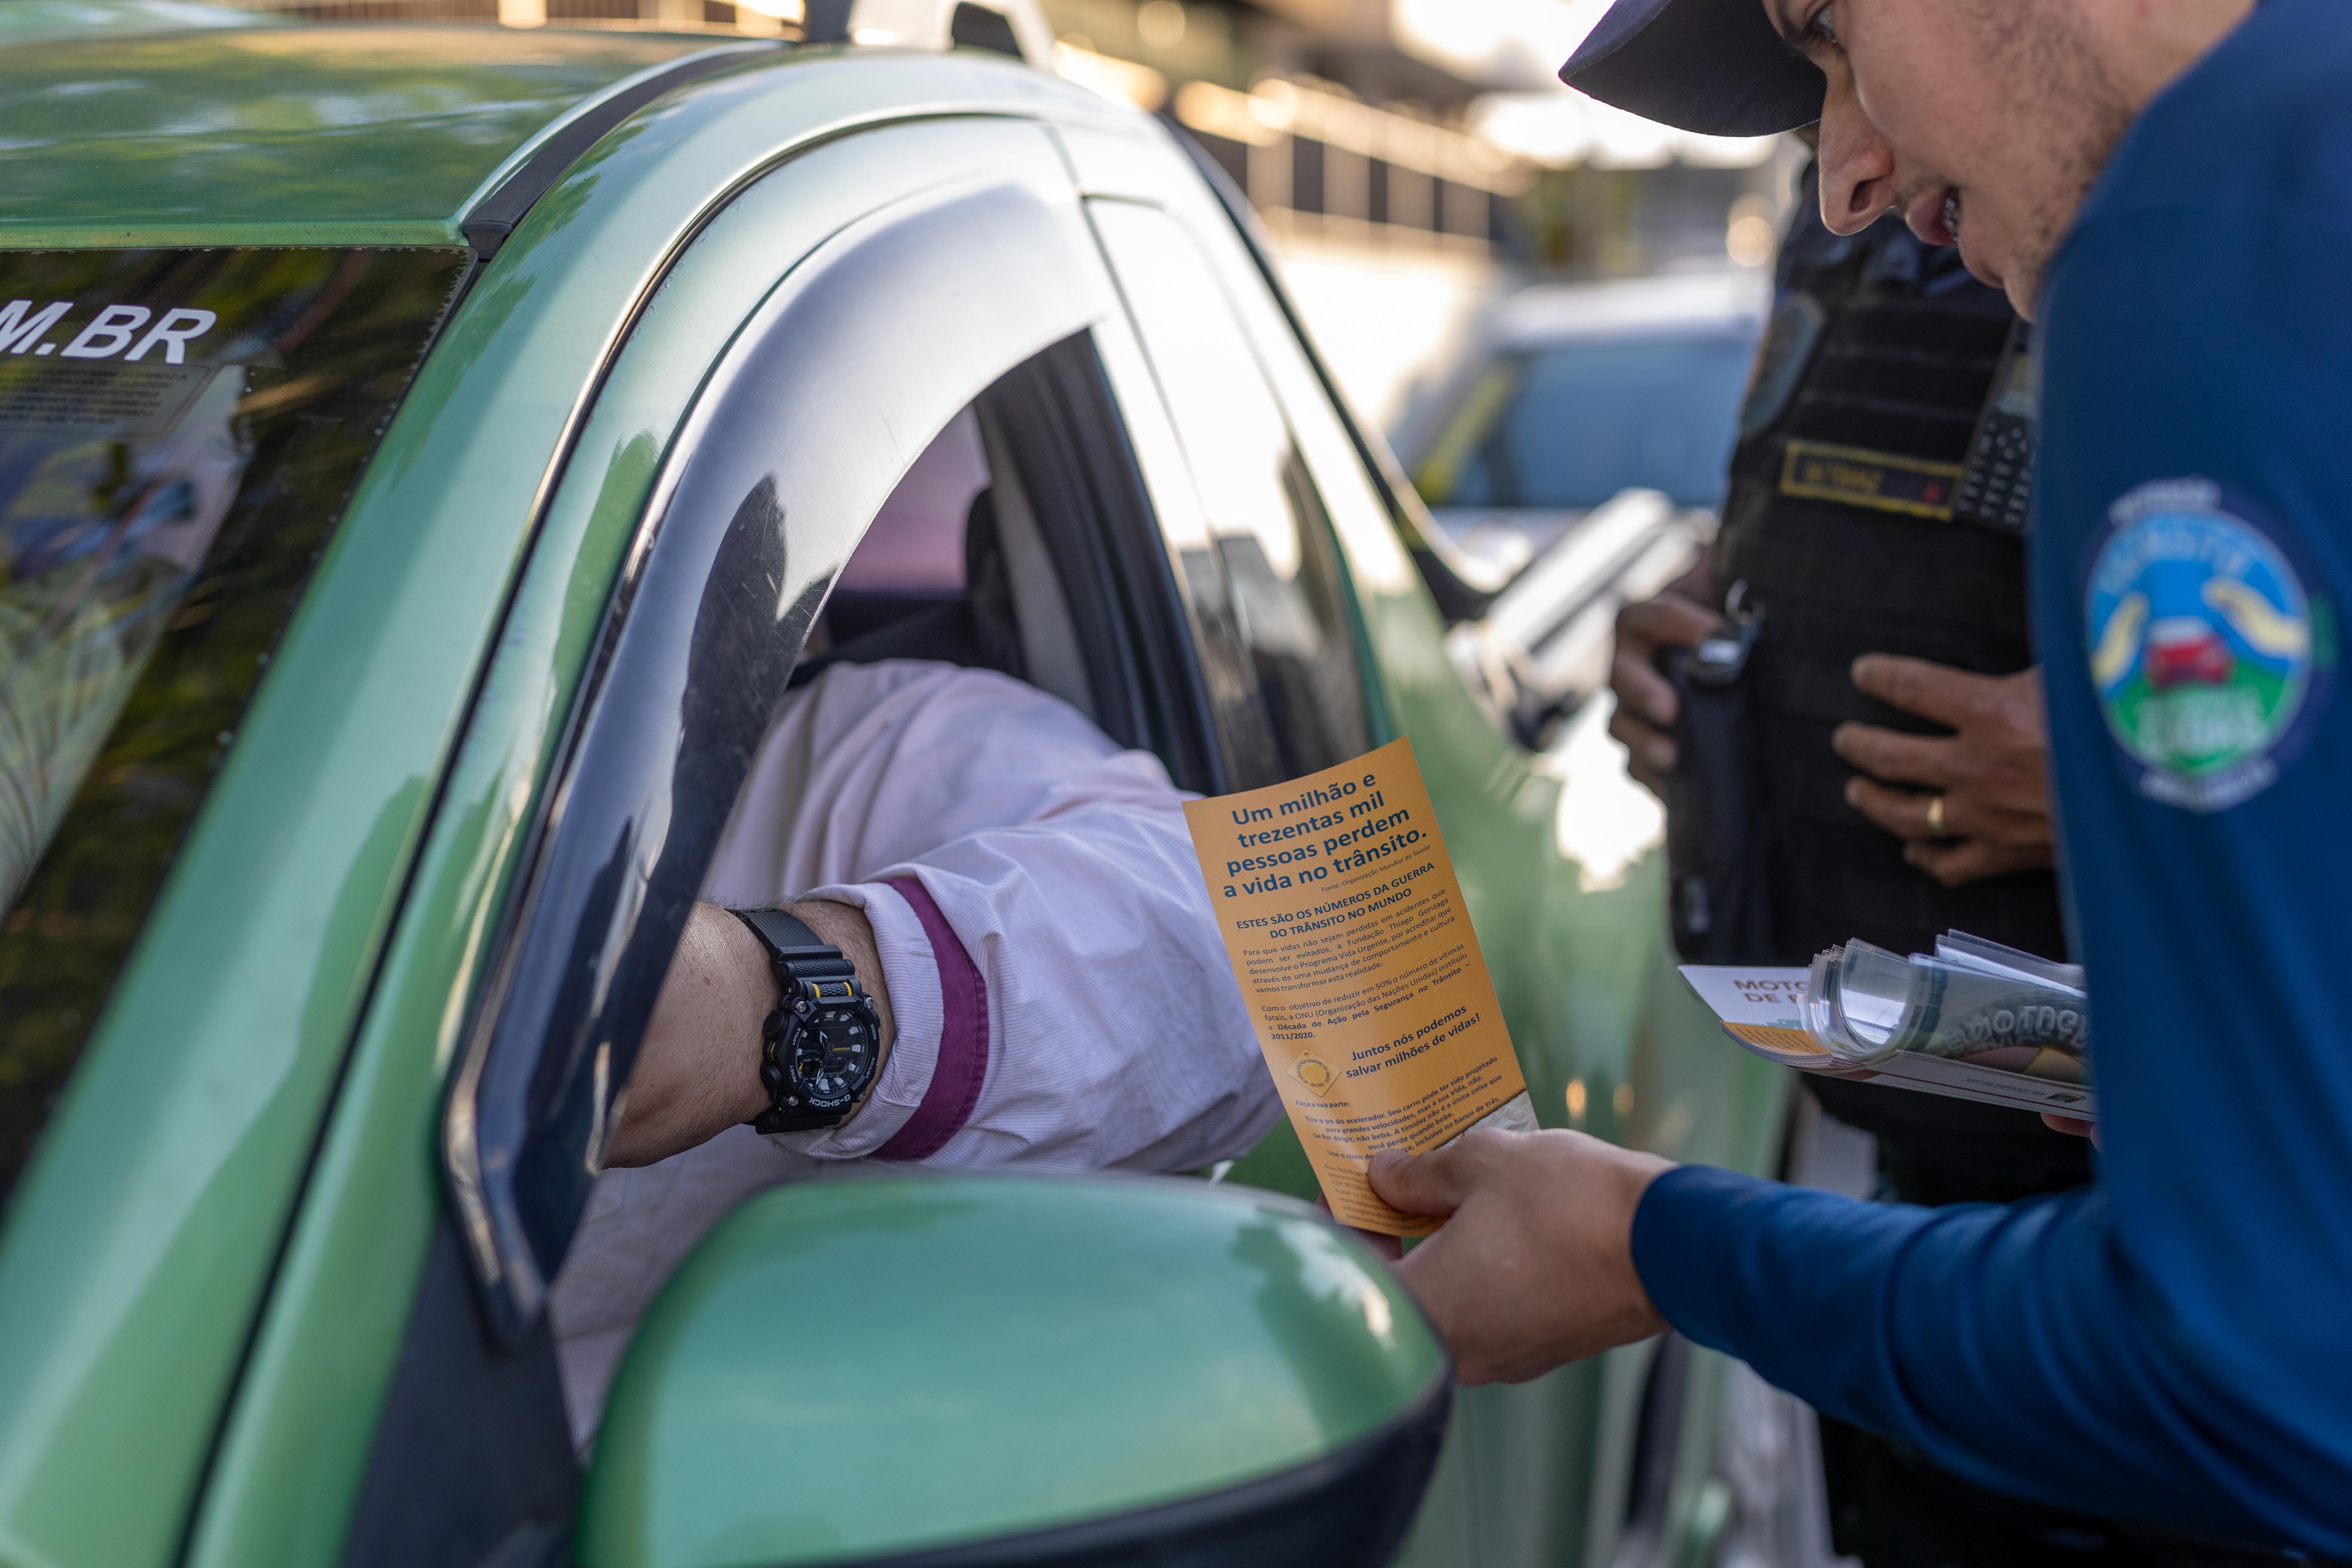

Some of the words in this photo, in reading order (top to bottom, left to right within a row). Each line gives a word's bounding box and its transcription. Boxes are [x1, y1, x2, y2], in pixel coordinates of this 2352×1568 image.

[1232, 808, 1273, 825] Um
[1279, 782, 1357, 816] milhão
[1363, 774, 1376, 787] e
[1237, 811, 1344, 848] trezentas
[1349, 790, 1384, 818] mil
[1223, 885, 1237, 897] a
[1242, 873, 1292, 894] vida
[1298, 867, 1328, 884] no
[1332, 830, 1427, 873] trânsito.
[1227, 844, 1318, 878] pessoas
[1323, 809, 1409, 856] perdem
[1321, 884, 1341, 892] Fonte:
[1342, 870, 1378, 886] Organização
[1379, 857, 1404, 872] Mundial
[1412, 845, 1430, 857] Saúde
[1236, 918, 1268, 929] ESTES
[1270, 913, 1293, 925] SÃO
[1296, 909, 1312, 919] OS
[1314, 891, 1371, 916] NÚMEROS
[1373, 884, 1390, 896] DA
[1391, 862, 1435, 888] GUERRA
[1270, 928, 1287, 939] DO
[1289, 914, 1345, 935] TRÂNSITO
[1348, 907, 1365, 920] NO
[1367, 888, 1412, 913] MUNDO
[1320, 933, 1344, 943] sejam
[1346, 921, 1379, 937] perdidas
[1381, 915, 1393, 923] em
[1395, 897, 1430, 917] acidentes
[1432, 889, 1446, 900] que
[1246, 958, 1274, 967] podem
[1296, 947, 1332, 959] evitados,
[1347, 929, 1384, 946] Fundação
[1388, 916, 1414, 930] Thiago
[1418, 898, 1449, 916] Gonzaga
[1250, 965, 1292, 974] desenvolve
[1300, 956, 1338, 968] Programa
[1338, 950, 1356, 959] Vida
[1357, 938, 1390, 953] Urgente,
[1391, 931, 1404, 942] por
[1405, 915, 1436, 934] acreditar
[1438, 907, 1452, 918] que
[1313, 963, 1349, 976] mudança
[1363, 934, 1422, 962] comportamento
[1430, 916, 1455, 932] cultura
[1281, 979, 1327, 991] transformar
[1328, 975, 1344, 983] esta
[1345, 962, 1383, 978] realidade.
[1289, 1001, 1321, 1010] objetivo
[1333, 991, 1360, 1003] reduzir
[1375, 978, 1392, 990] 50%
[1399, 964, 1428, 980] número
[1438, 944, 1464, 960] vítimas
[1315, 1000, 1366, 1017] (Organização
[1367, 995, 1381, 1004] das
[1381, 983, 1409, 998] Nações
[1409, 968, 1438, 986] Unidas)
[1438, 953, 1467, 972] instituiu
[1327, 1016, 1347, 1025] Ação
[1352, 1010, 1369, 1020] pela
[1374, 992, 1414, 1012] Segurança
[1418, 985, 1428, 993] no
[1431, 968, 1461, 986] Trânsito
[1743, 993, 1782, 1003] DE
[792, 1027, 801, 1046] START
[1271, 1032, 1316, 1041] 2011/2020.
[1346, 1063, 1381, 1078] salvar
[1384, 1042, 1430, 1068] milhões
[1432, 1034, 1446, 1046] de
[1447, 1012, 1480, 1037] vidas!
[1352, 1043, 1391, 1061] Juntos
[1393, 1034, 1414, 1048] nós
[1416, 1006, 1467, 1039] podemos
[865, 1057, 875, 1079] ADJUST
[1346, 1113, 1386, 1124] acelerador.
[1387, 1108, 1402, 1117] Seu
[1403, 1100, 1421, 1111] carro
[1421, 1090, 1439, 1103] pode
[1439, 1084, 1452, 1093] ter
[1450, 1075, 1464, 1086] sido
[1465, 1057, 1498, 1079] projetado
[808, 1094, 851, 1107] G-SHOCK
[1342, 1126, 1370, 1134] grandes
[1371, 1113, 1416, 1130] velocidades,
[1417, 1104, 1431, 1115] mas
[1437, 1094, 1449, 1103] sua
[1451, 1085, 1467, 1096] Vida,
[1468, 1076, 1483, 1086] não.
[1401, 1117, 1427, 1132] timidez
[1427, 1109, 1440, 1119] não
[1452, 1093, 1470, 1105] única
[1471, 1083, 1487, 1095] coisa
[1488, 1075, 1502, 1087] que
[1415, 1128, 1443, 1147] inclusive
[1444, 1122, 1453, 1130] no
[1454, 1111, 1475, 1125] banco
[1485, 1097, 1500, 1107] trás.
[1367, 1142, 1385, 1150] você
[1387, 1136, 1408, 1148] perde
[1409, 1123, 1435, 1139] quando
[1435, 1112, 1453, 1125] bebe.
